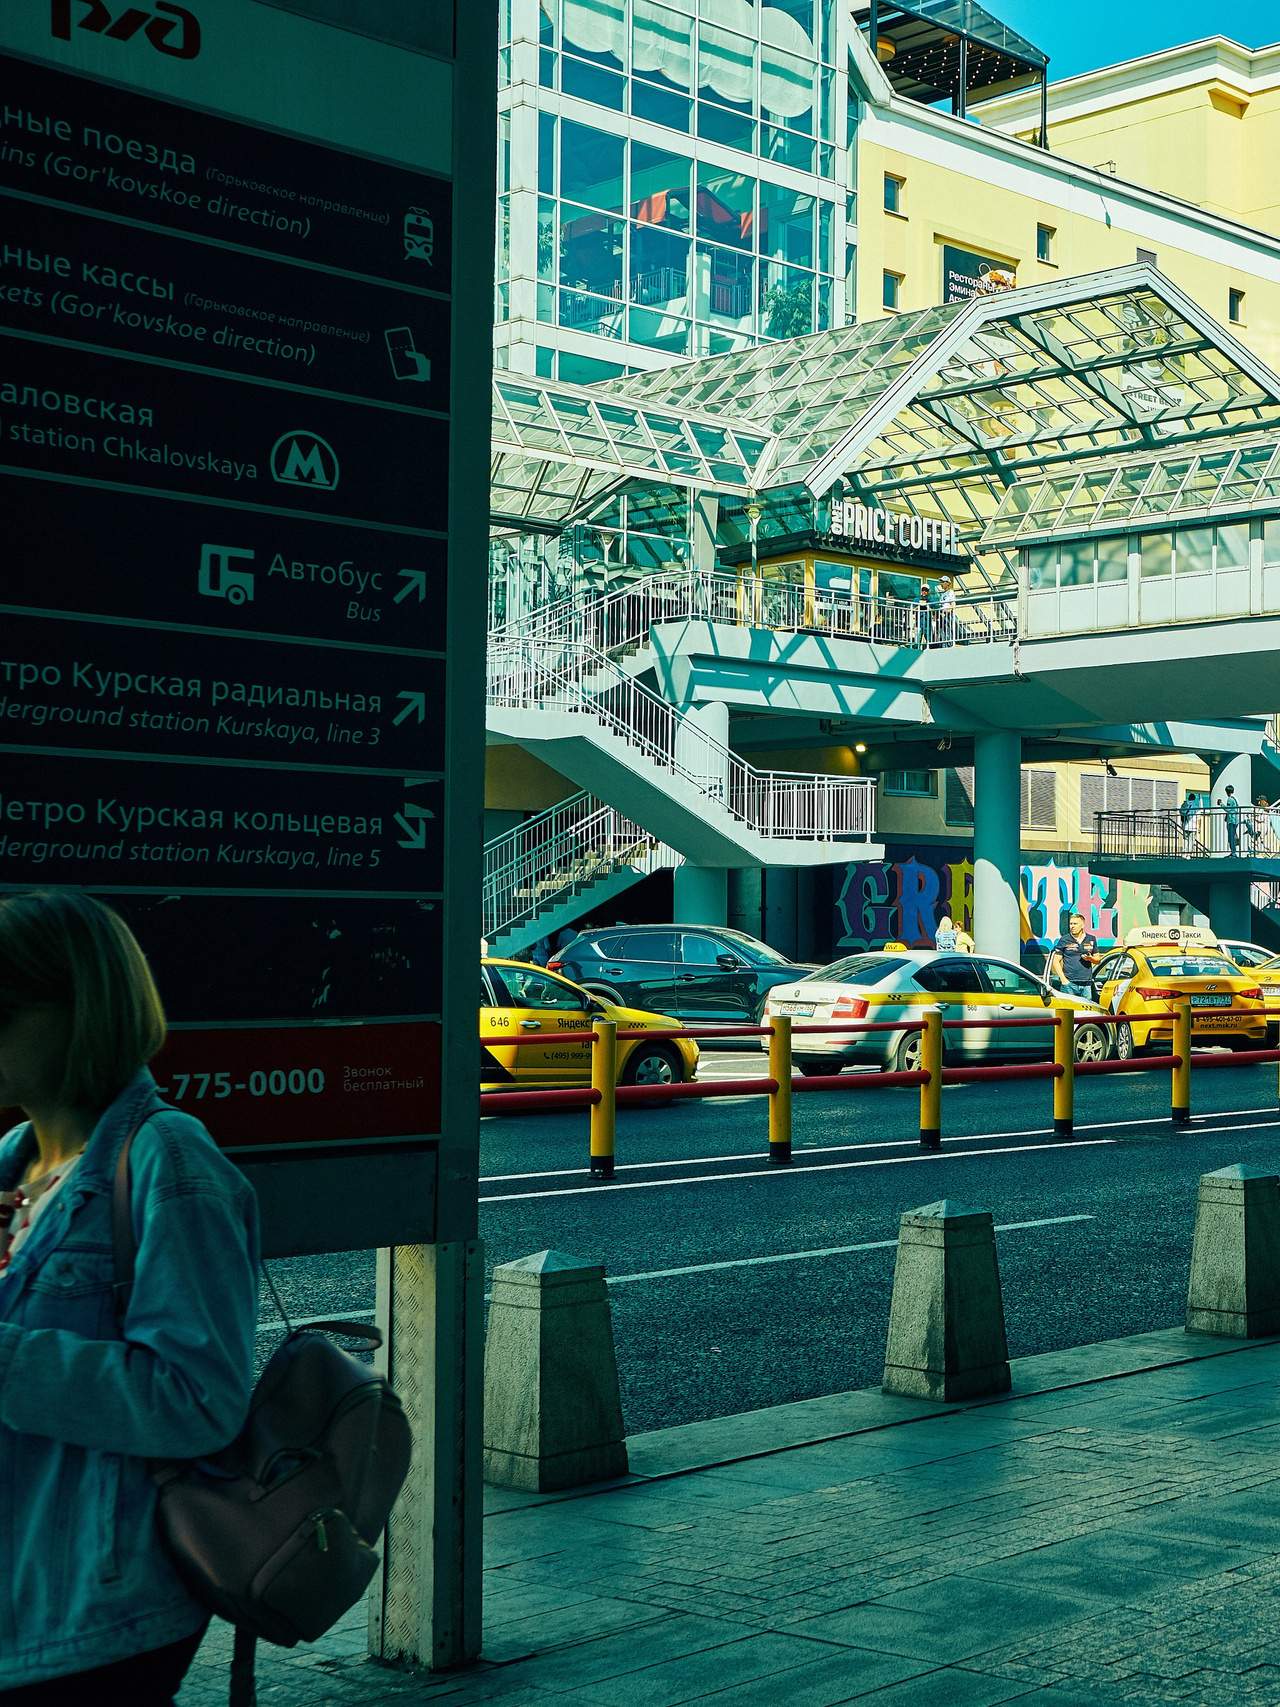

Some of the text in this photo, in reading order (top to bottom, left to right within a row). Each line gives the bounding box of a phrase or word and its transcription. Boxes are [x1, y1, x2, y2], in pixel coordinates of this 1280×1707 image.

[0, 104, 391, 225] ные поезда (Горьковское направление)
[44, 151, 201, 209] (Gor'kovskoe
[207, 197, 312, 238] direction)
[0, 244, 371, 344] ные кассы (Горьковское направление)
[949, 270, 995, 292] Рестораны
[51, 291, 207, 341] (Gor'kovskoe
[212, 323, 317, 365] direction)
[0, 383, 154, 427] аловская
[9, 423, 258, 481] station Chkalovskaya
[843, 502, 895, 545] PRICE
[899, 513, 960, 556] COFFEE
[267, 553, 383, 594] Автобус
[346, 601, 382, 622] Bus
[0, 661, 382, 713] тро Курская радиальная
[129, 711, 209, 732] station
[217, 716, 321, 743] Kurskaya,
[326, 727, 364, 744] line
[367, 729, 381, 745] 3
[0, 794, 383, 837] етро Курская кольцевая
[128, 842, 209, 862] station
[217, 844, 321, 869] Kurskaya,
[326, 849, 364, 867] line
[368, 850, 381, 867] 5
[1141, 931, 1168, 939] Яндекс
[1169, 930, 1180, 939] Go
[490, 1017, 510, 1027] 646
[557, 1018, 590, 1029] Яндекс
[342, 1066, 392, 1079] Звонок
[551, 1052, 569, 1060] (495)
[343, 1077, 424, 1093] бесплатный
